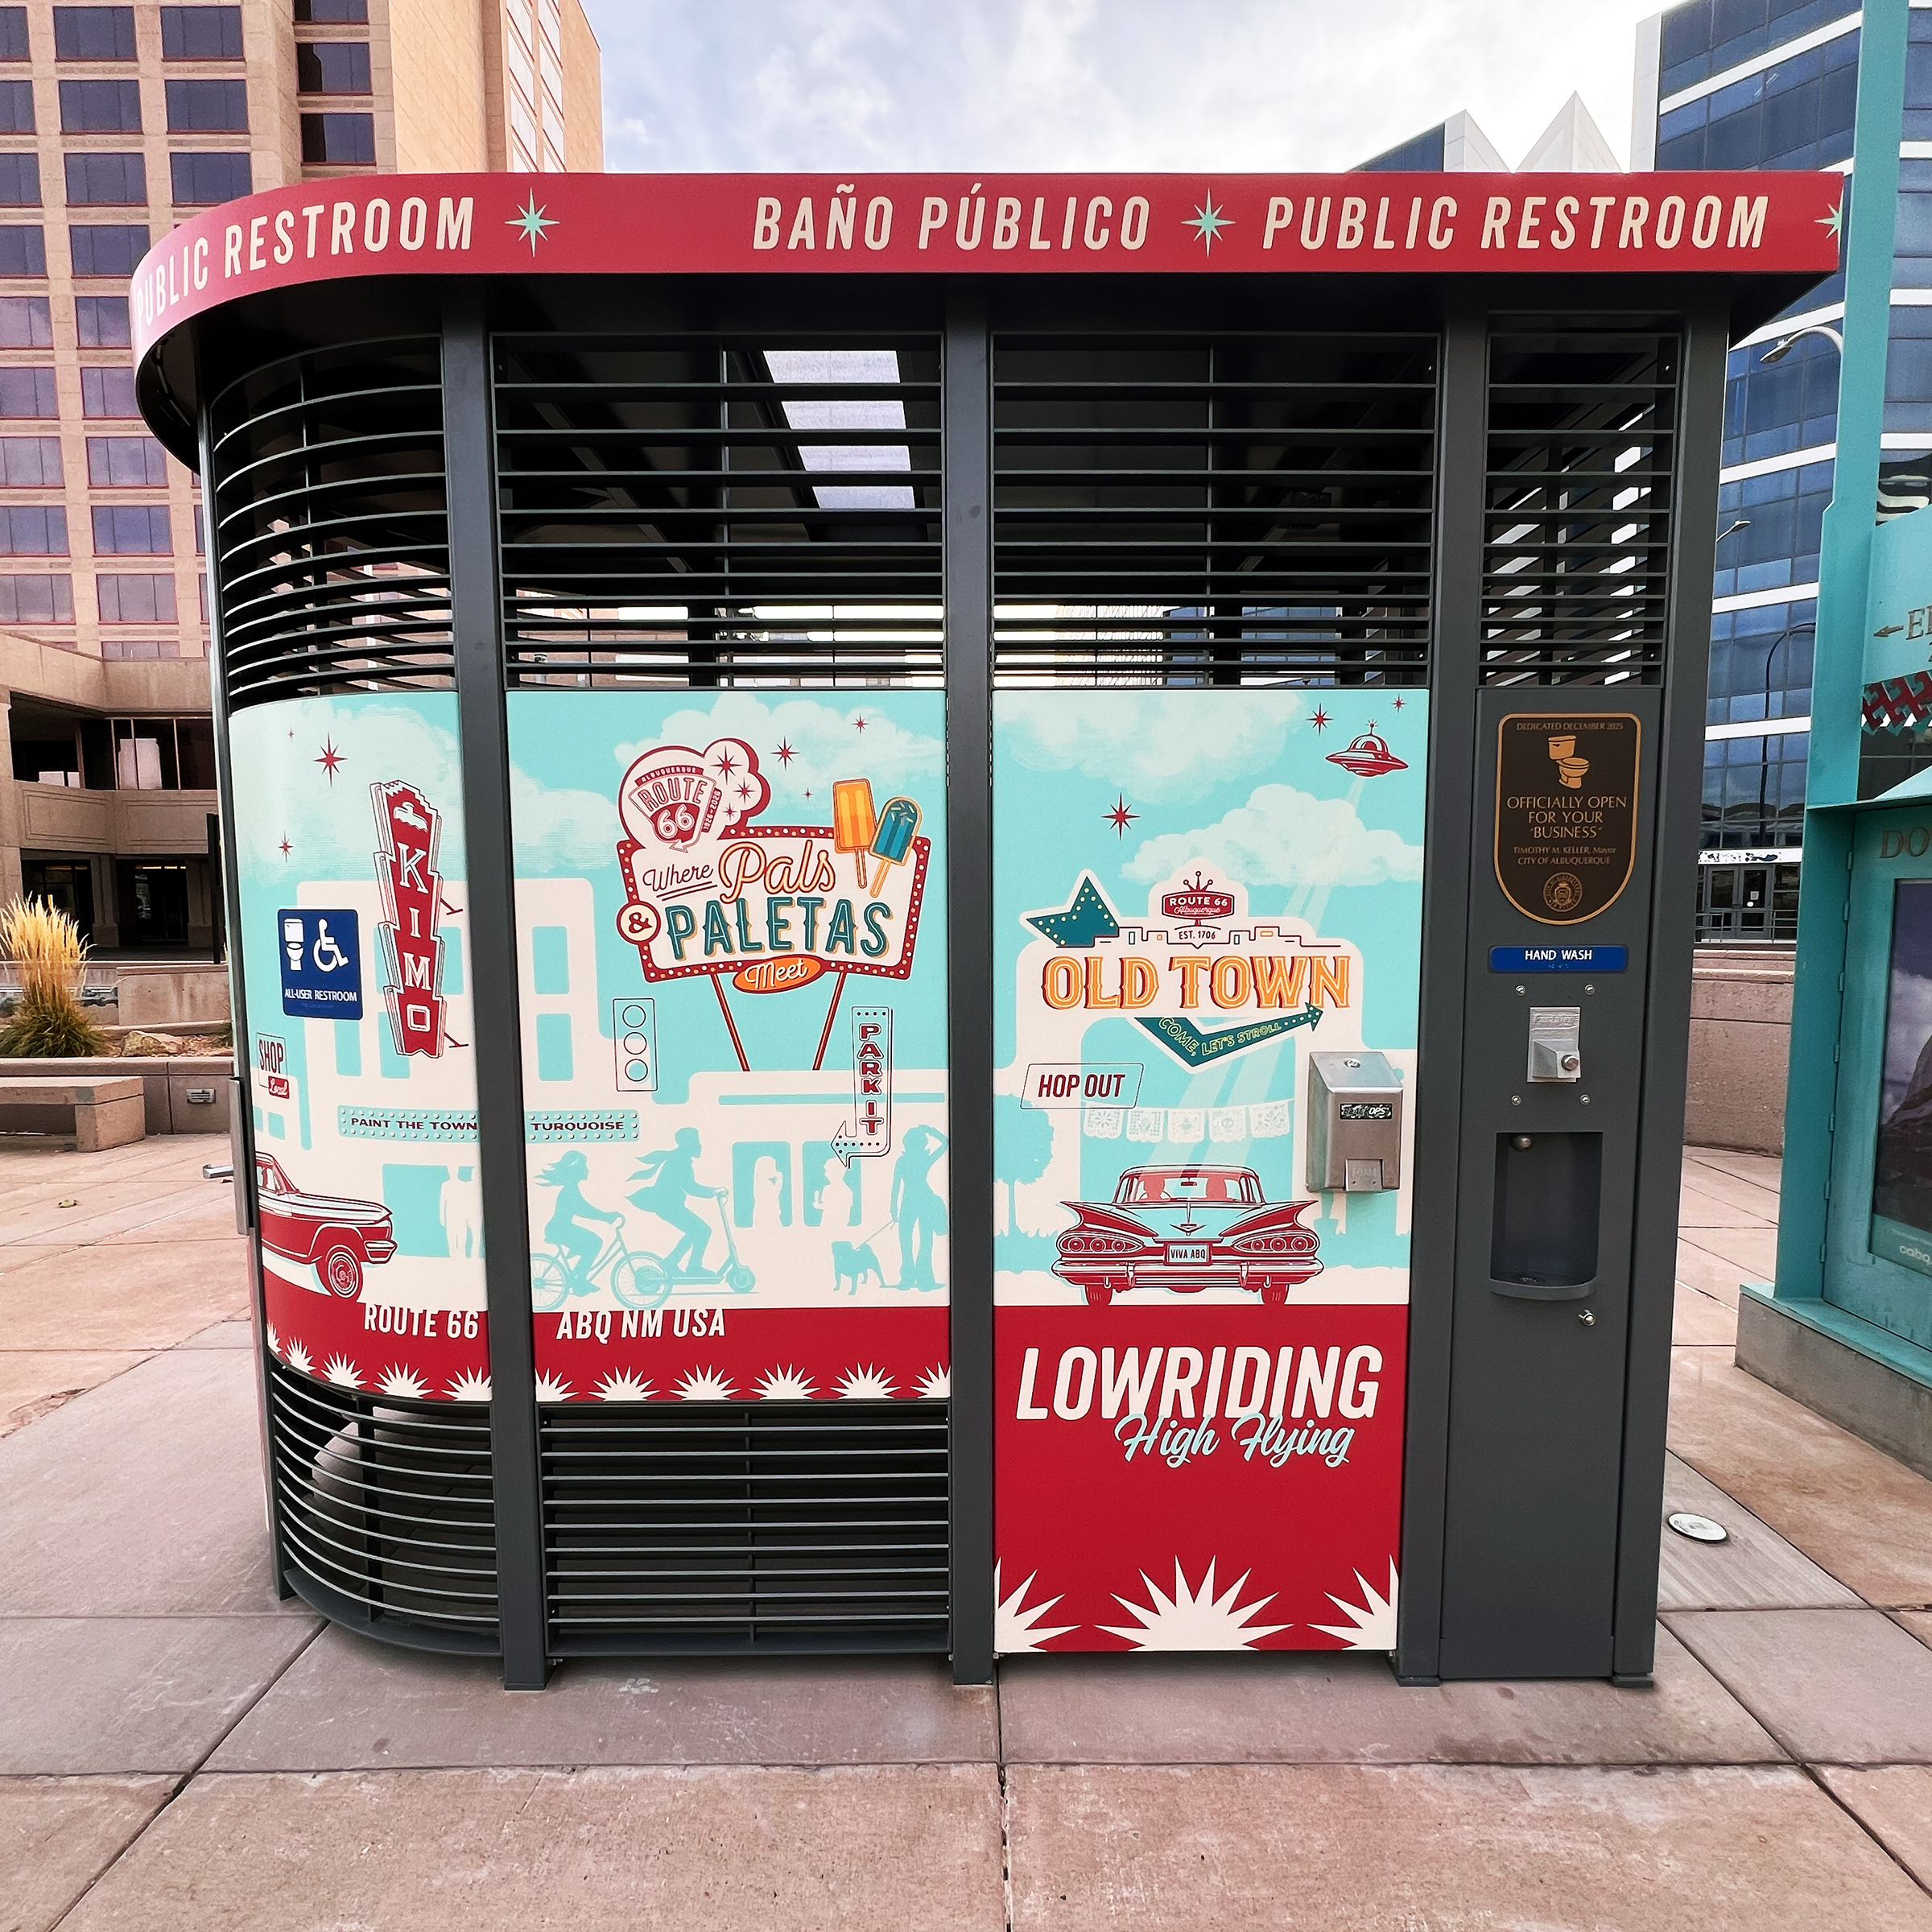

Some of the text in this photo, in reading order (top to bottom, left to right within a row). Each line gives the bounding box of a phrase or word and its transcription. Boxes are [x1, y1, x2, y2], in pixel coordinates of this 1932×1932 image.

[752, 182, 1151, 250] BAÑO PÚBLICO
[1262, 195, 1769, 250] PUBLIC RESTROOM
[137, 196, 474, 338] PUBLIC RESTROOM
[1516, 722, 1624, 731] DEDICATED DECEMBER 2025
[640, 766, 697, 782] ALBUQUERQUE
[638, 777, 708, 812] ROUTE
[703, 790, 722, 831] 1926-2026
[1507, 795, 1628, 809] OFFICIALLY OPEN
[656, 804, 696, 840] 66
[1528, 811, 1604, 824] FOR YOUR
[1513, 846, 1550, 854] TIMOTHY
[1563, 846, 1591, 855] KELLER,
[1592, 846, 1616, 856] Mayor
[1517, 856, 1611, 866] CITY OF ALBUQUERQUE
[642, 839, 836, 904] Where Pals
[1169, 896, 1228, 907] ROUTE 66
[1173, 905, 1221, 916] Albuquerque
[397, 841, 434, 1032] KIMO
[664, 896, 894, 961] PALETAS
[1179, 931, 1216, 940] EST. 1706
[1525, 949, 1593, 960] HAND WASH
[743, 958, 808, 989] Meet
[1040, 956, 1351, 1009] OLD TOWN
[284, 989, 357, 1002] ALL-USER RESTROOM
[1201, 1034, 1236, 1056] LET'S
[1236, 1022, 1282, 1043] STROLL
[258, 1039, 284, 1074] SHOP
[857, 1023, 885, 1095] PARK
[1038, 1073, 1126, 1098] HOP OUT
[350, 1117, 625, 1132] PAINT THE TOWN TURQUOISE
[859, 1099, 885, 1135] IT
[1368, 1107, 1386, 1115] OPS
[1170, 1249, 1207, 1261] VIVA ABQ
[364, 1302, 480, 1340] ROUTE 66
[555, 1309, 726, 1345] ABQ NM USA
[1015, 1344, 1384, 1421] LOWRIDING
[1113, 1411, 1356, 1469] High Flying
